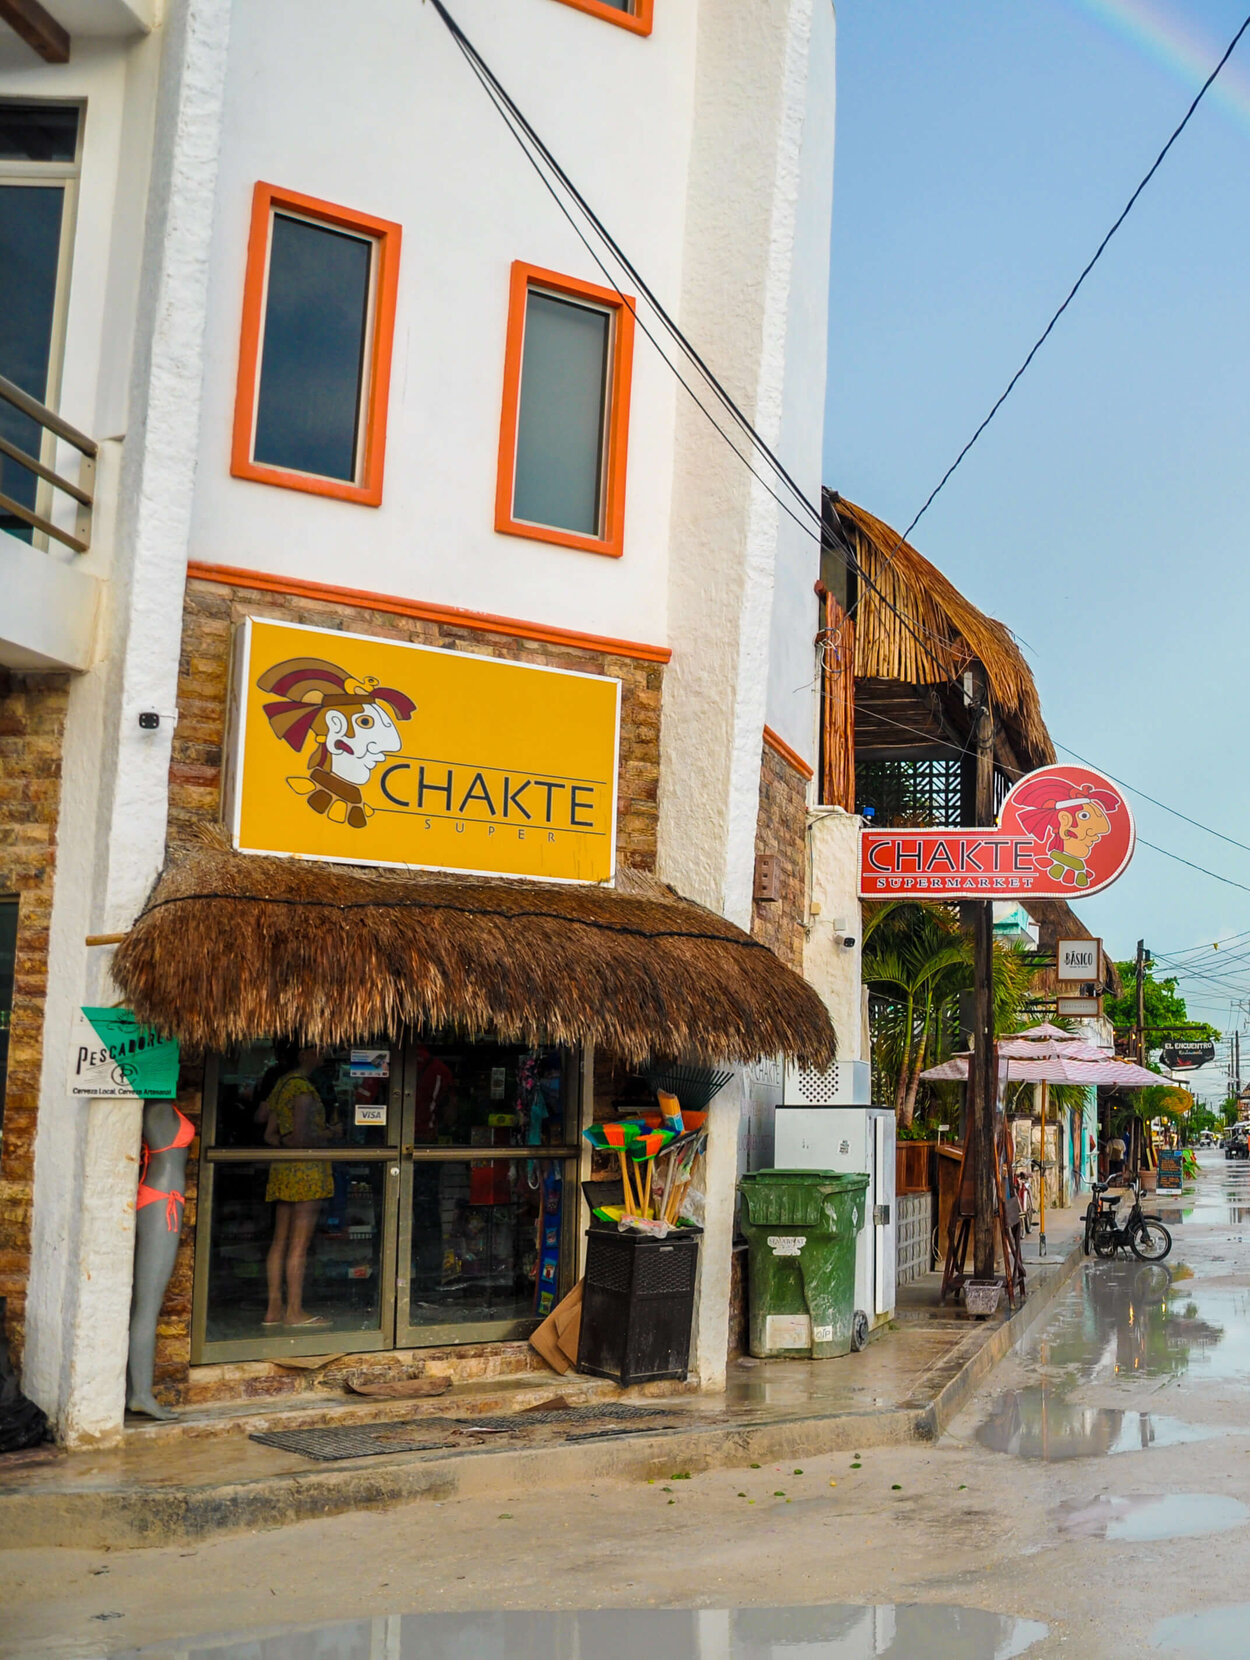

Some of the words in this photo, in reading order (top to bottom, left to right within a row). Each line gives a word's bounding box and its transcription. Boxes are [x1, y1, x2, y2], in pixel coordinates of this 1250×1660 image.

[380, 763, 595, 828] CHAKTE
[424, 818, 556, 843] SUPER
[868, 840, 1034, 872] CHAKTE
[876, 877, 1034, 889] SUPERMARKET
[1164, 1042, 1174, 1050] EL
[1174, 1042, 1212, 1050] ENCUENTRO
[361, 1111, 382, 1119] VISA
